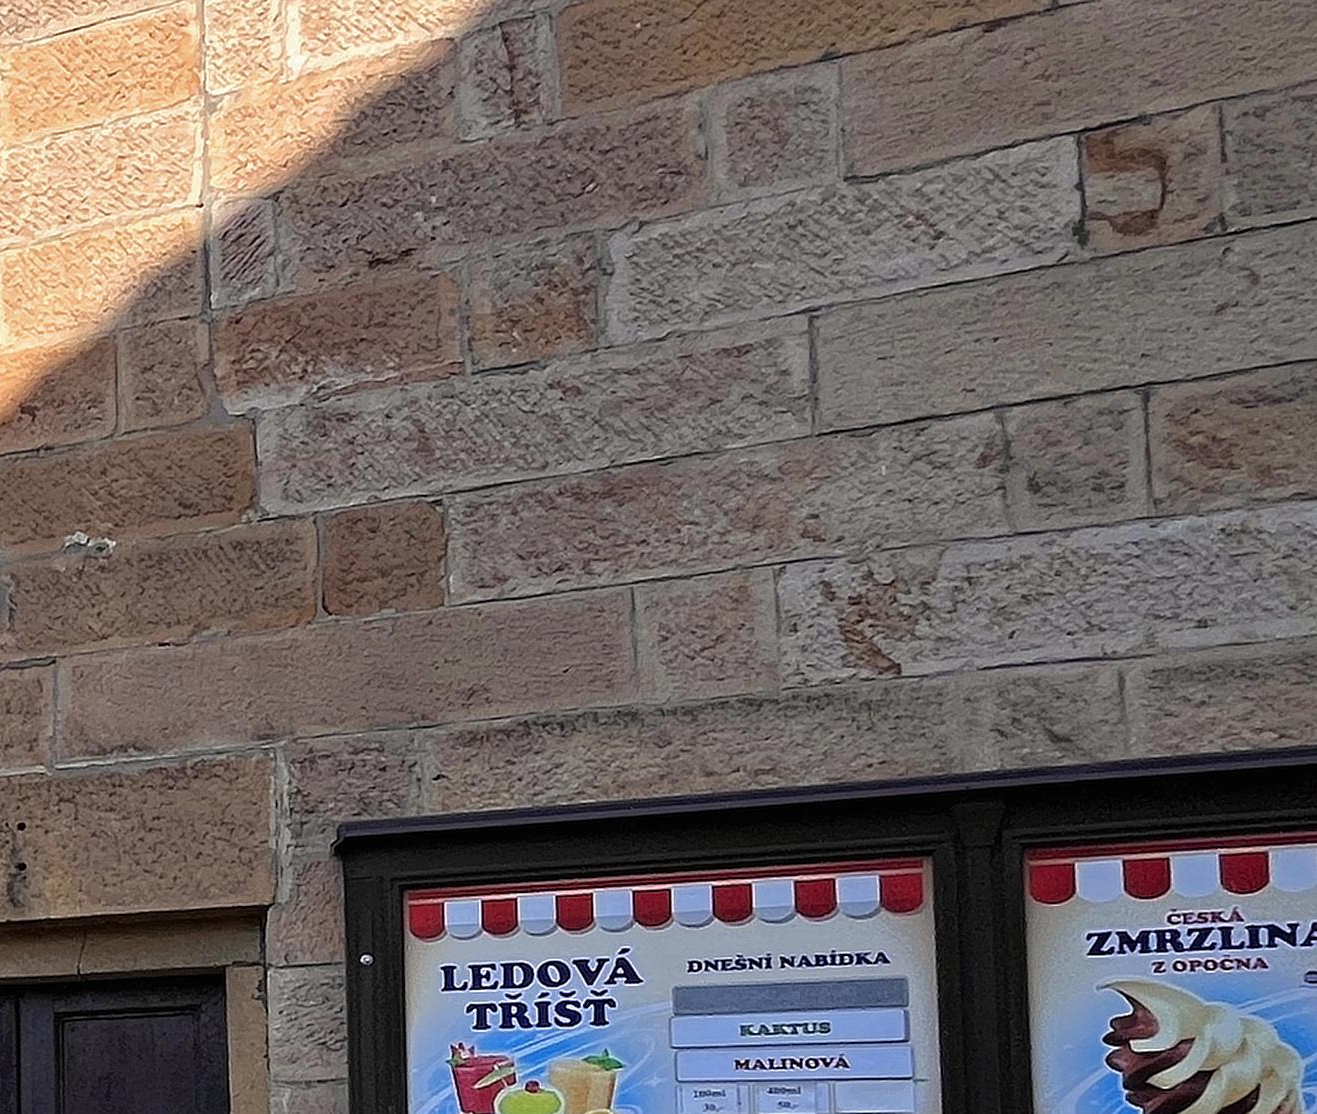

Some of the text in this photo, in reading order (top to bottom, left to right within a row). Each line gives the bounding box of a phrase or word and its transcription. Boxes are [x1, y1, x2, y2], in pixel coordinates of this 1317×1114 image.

[1167, 906, 1245, 925] ČESKÁ
[440, 948, 644, 992] LEDOVÁ
[686, 950, 891, 973] DNEŠNÍ NABÍDKA
[1152, 955, 1269, 973] Z OPOČNA
[466, 989, 617, 1031] TŘÍŠŤ
[739, 1022, 832, 1037] KAKTUS
[734, 1054, 850, 1071] MALINOVÁ
